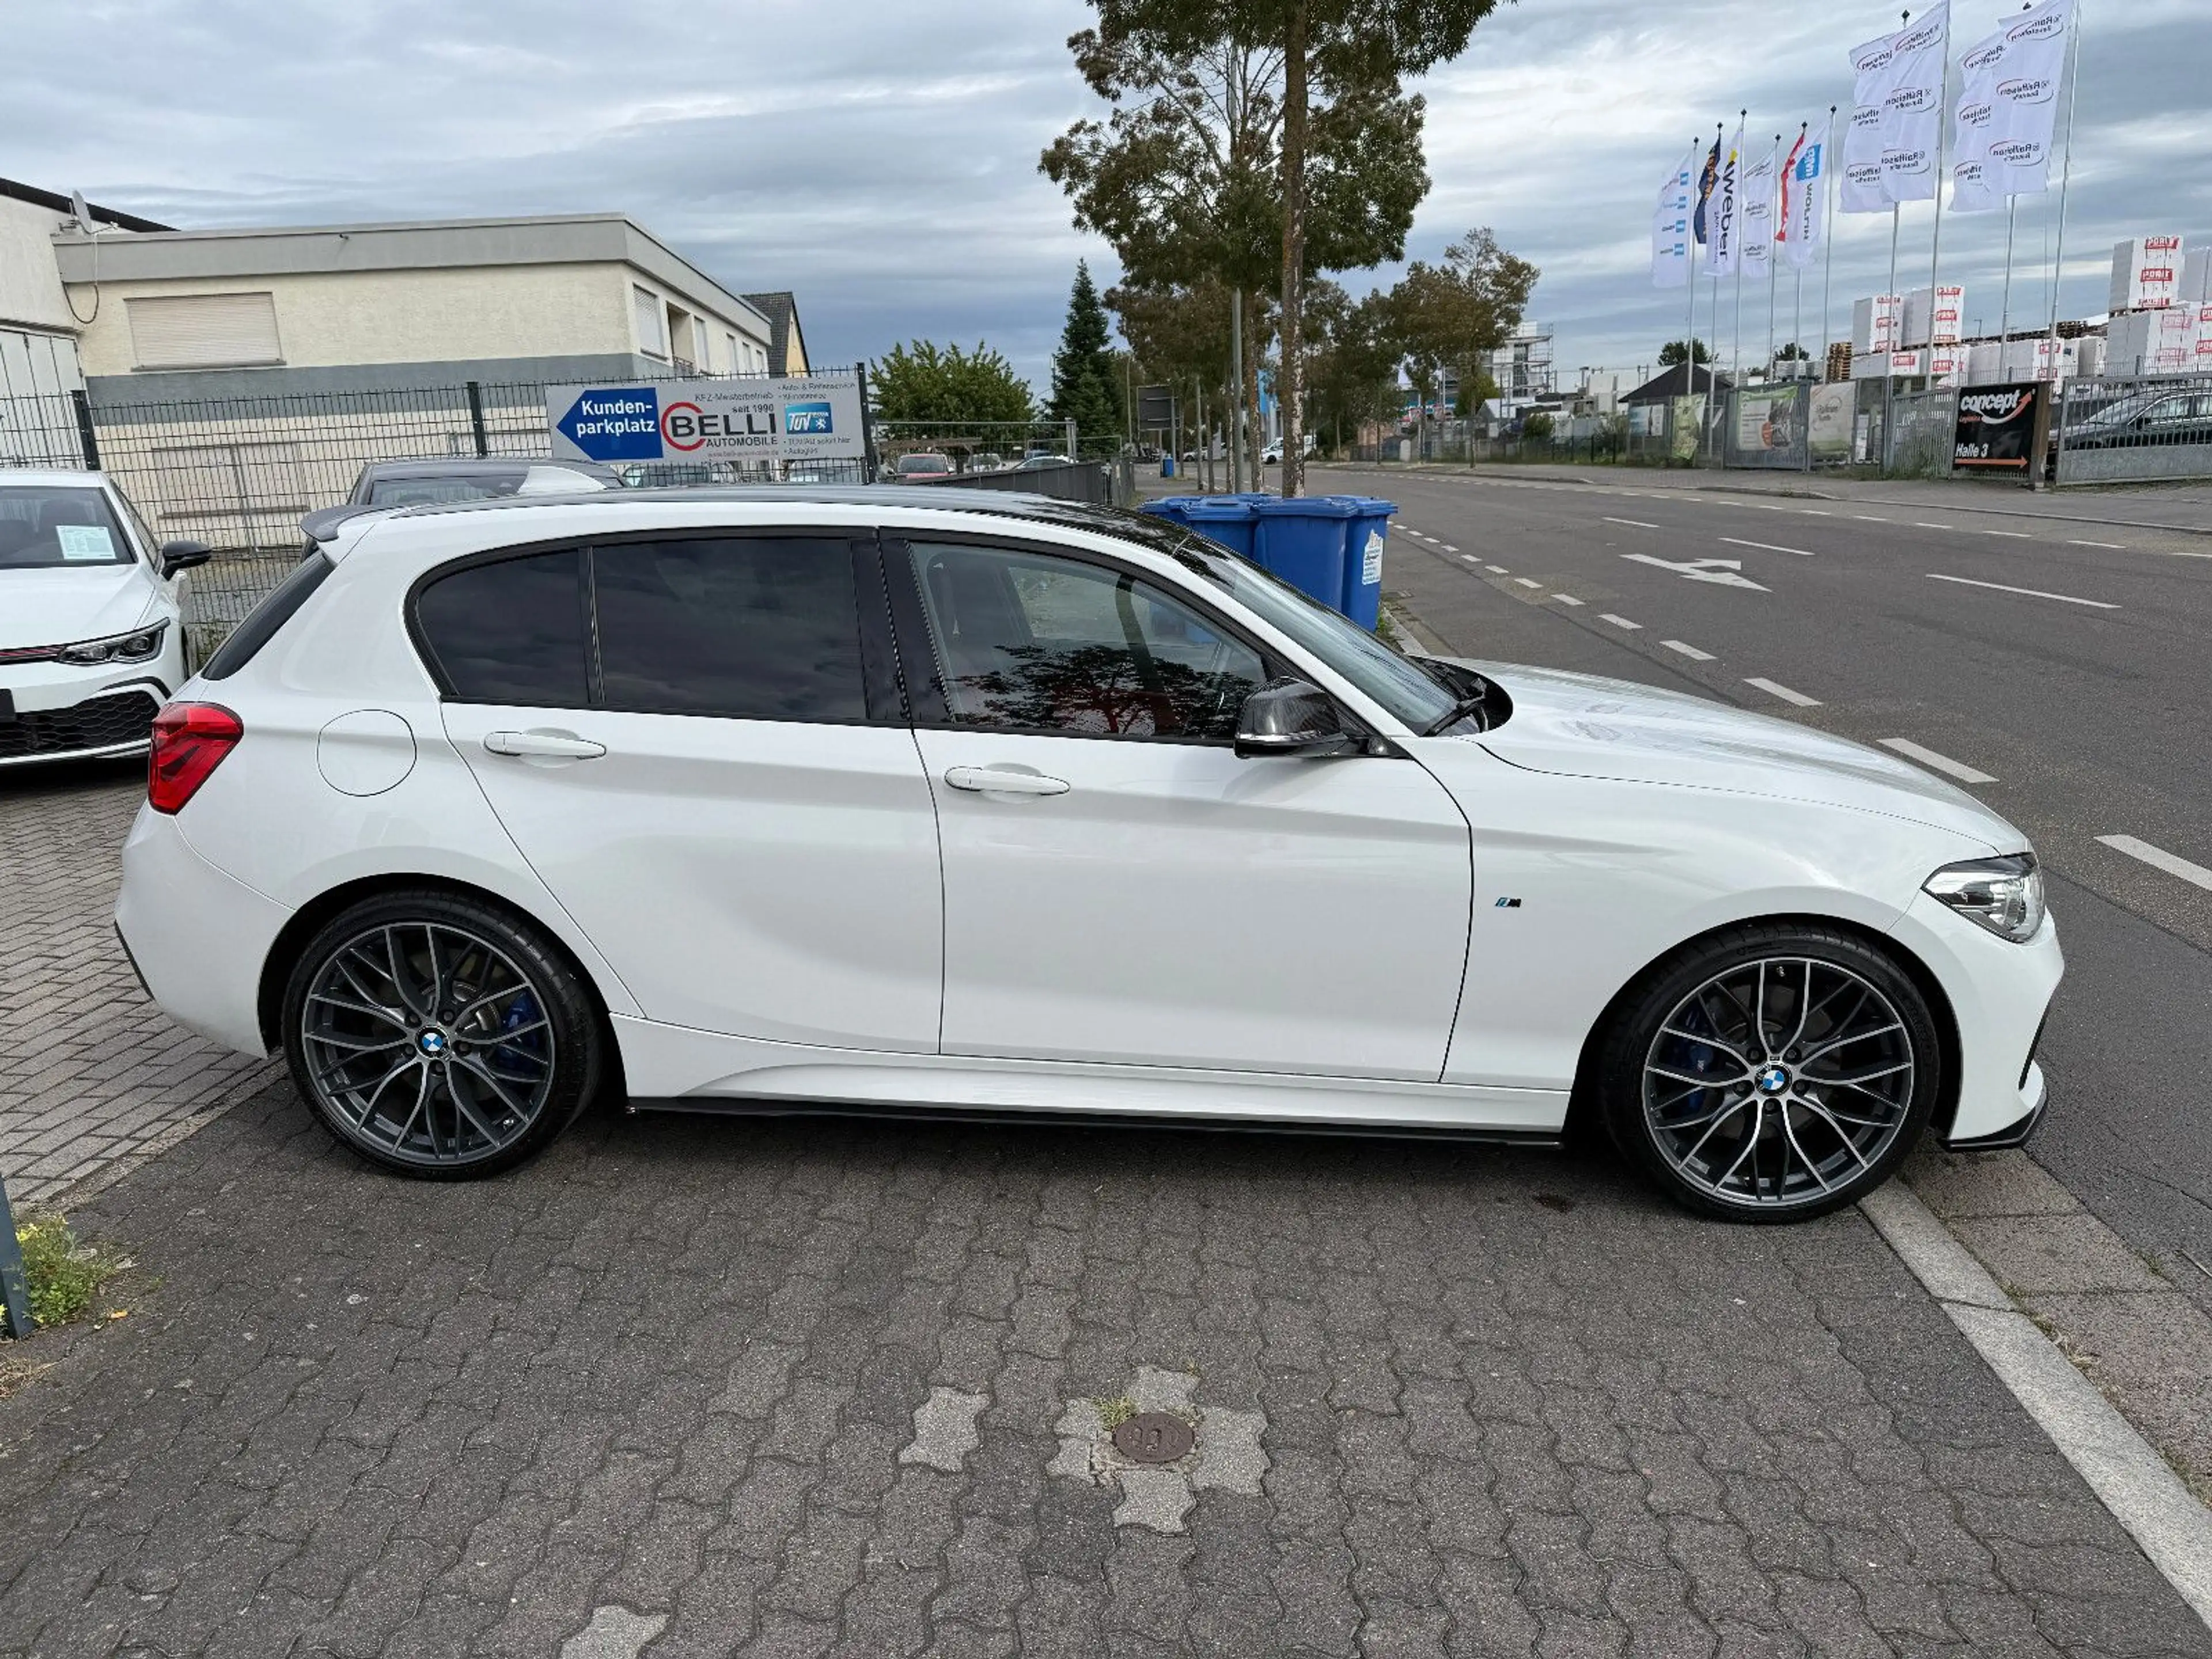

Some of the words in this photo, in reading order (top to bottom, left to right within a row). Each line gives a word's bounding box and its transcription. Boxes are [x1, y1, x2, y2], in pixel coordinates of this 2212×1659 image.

[1719, 168, 1735, 260] weber
[582, 399, 653, 415] Kunden-
[732, 405, 750, 414] seit
[753, 403, 774, 413] 1990
[1960, 389, 2021, 414] concept
[577, 418, 656, 438] parkplatz
[671, 413, 777, 437] BELLI
[706, 437, 778, 448] AUTOMOBILE
[1955, 443, 1979, 457] Halle
[1981, 444, 1989, 457] 3
